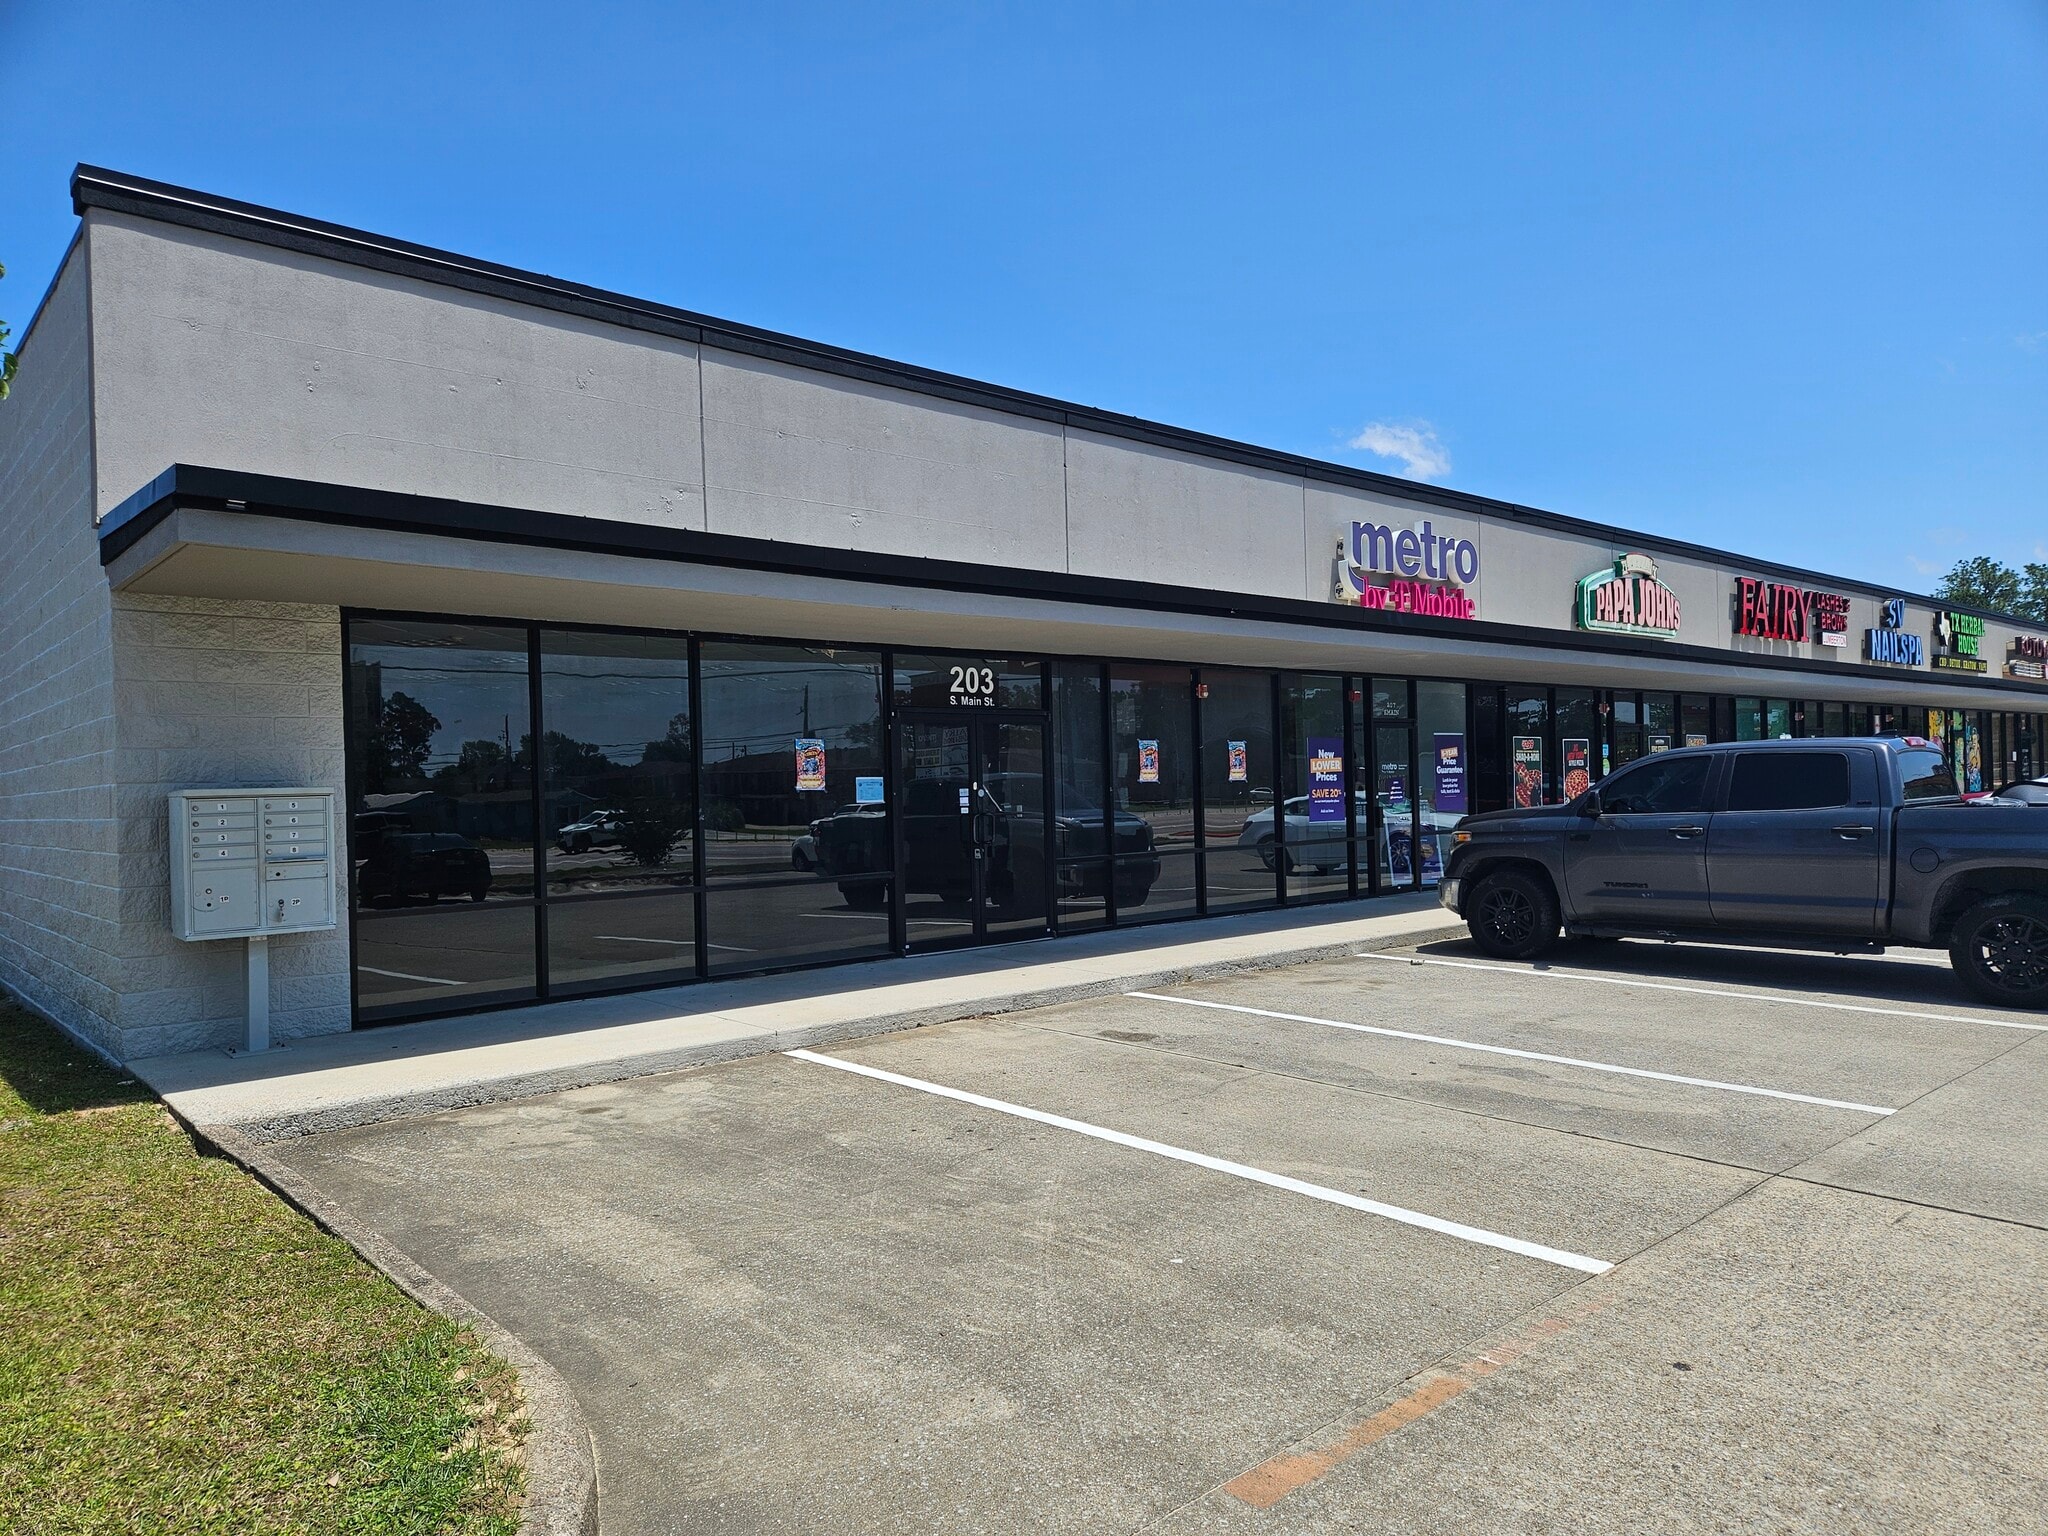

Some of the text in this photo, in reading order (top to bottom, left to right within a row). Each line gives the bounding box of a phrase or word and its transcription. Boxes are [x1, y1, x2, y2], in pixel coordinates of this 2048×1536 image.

[1345, 520, 1480, 585] metro
[1596, 577, 1681, 631] PAPA JOHNS
[1735, 577, 1814, 644] FAIRY
[1816, 593, 1844, 613] LASHES
[1885, 598, 1905, 628] SV
[1820, 612, 1848, 632] BROWS
[1950, 611, 1985, 637] TX HERBAL
[1957, 634, 1979, 656] HOUSE
[950, 665, 994, 695] 203
[950, 695, 995, 707] S. Main St.
[1318, 749, 1335, 759] New
[1311, 760, 1341, 771] LOWER
[1315, 771, 1338, 782] Prices
[1311, 788, 1330, 799] SAVE
